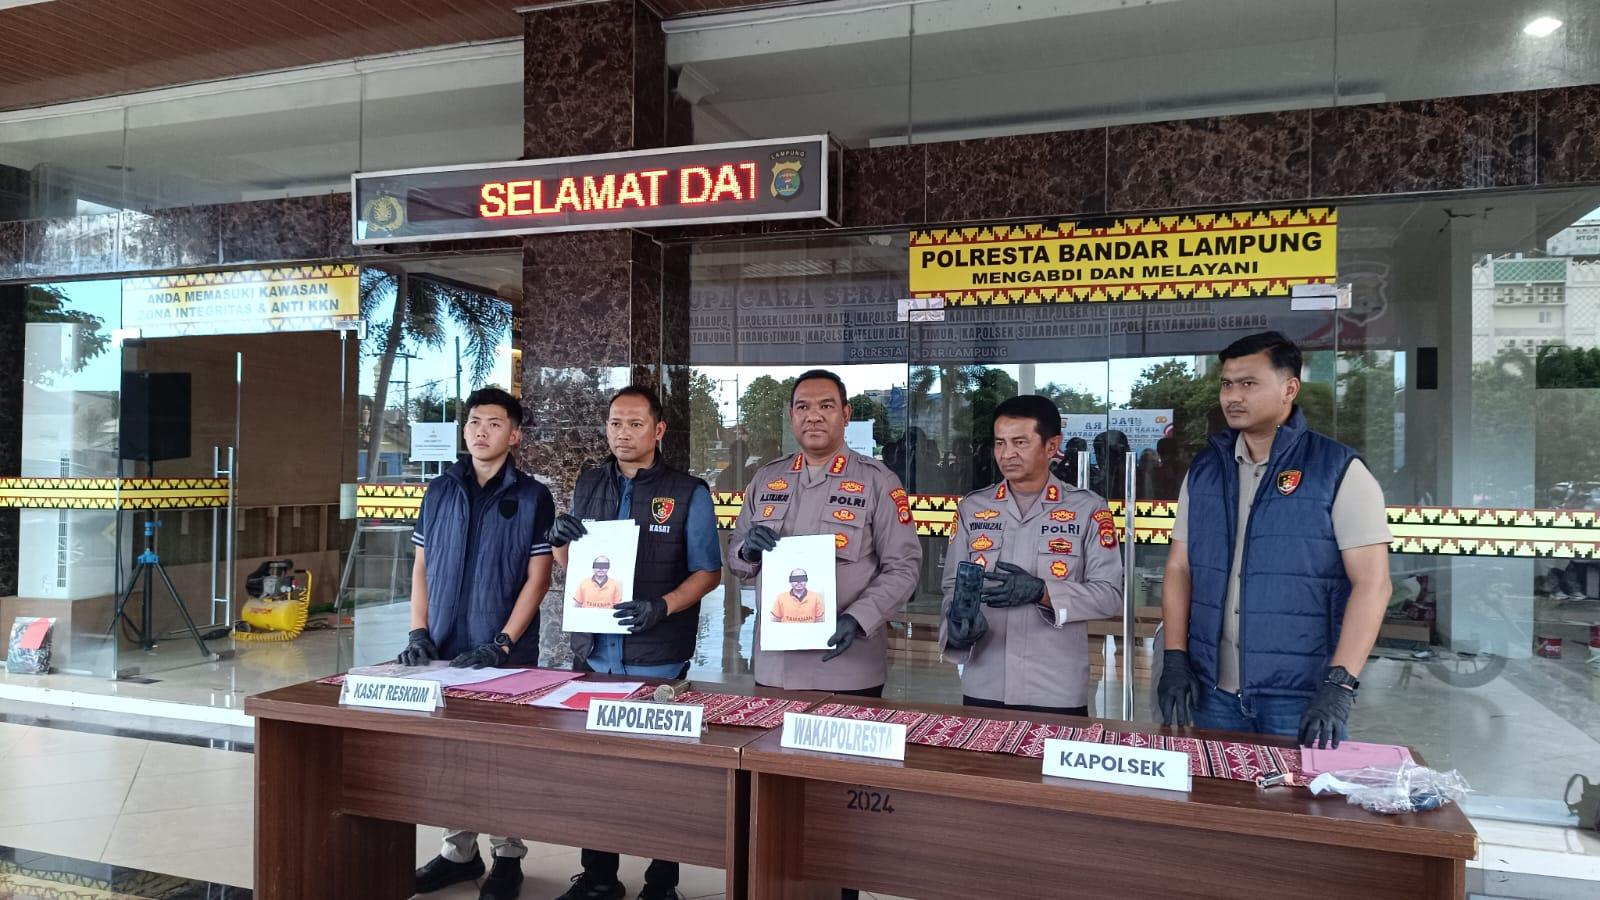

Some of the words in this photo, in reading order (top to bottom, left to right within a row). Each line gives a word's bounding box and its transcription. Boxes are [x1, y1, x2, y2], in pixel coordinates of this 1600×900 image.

[770, 149, 805, 159] LAMPUNG
[479, 170, 668, 218] SELAMAT
[922, 246, 1050, 269] POLRESTA
[1059, 239, 1168, 263] BANDAR
[1178, 231, 1322, 257] LAMPUNG
[972, 268, 1082, 285] MENGABDI
[1090, 266, 1134, 281] DAN
[1142, 261, 1259, 278] MELAYANI
[148, 292, 180, 304] ANDA
[185, 287, 255, 301] MEMASUKI
[259, 283, 329, 298] KAWASAN
[175, 304, 252, 318] INTEGRITAS
[253, 303, 266, 313] &
[271, 301, 303, 313] ANTI
[308, 299, 340, 311] KKN
[961, 325, 1014, 340] KAPOLSEK
[850, 348, 902, 359] POLRESTA
[948, 346, 1008, 357] LAMPUNG
[829, 495, 866, 508] POLRI
[649, 524, 671, 534] KASAT
[1041, 523, 1080, 535] POLRI
[353, 682, 385, 700] KASAT
[386, 684, 430, 703] RESKRIM
[596, 704, 693, 732] KAPOLRESTA
[793, 717, 894, 753] WAKAPOLRESTA
[1059, 751, 1166, 778] KAPOLSEK
[847, 790, 895, 813] 2024
